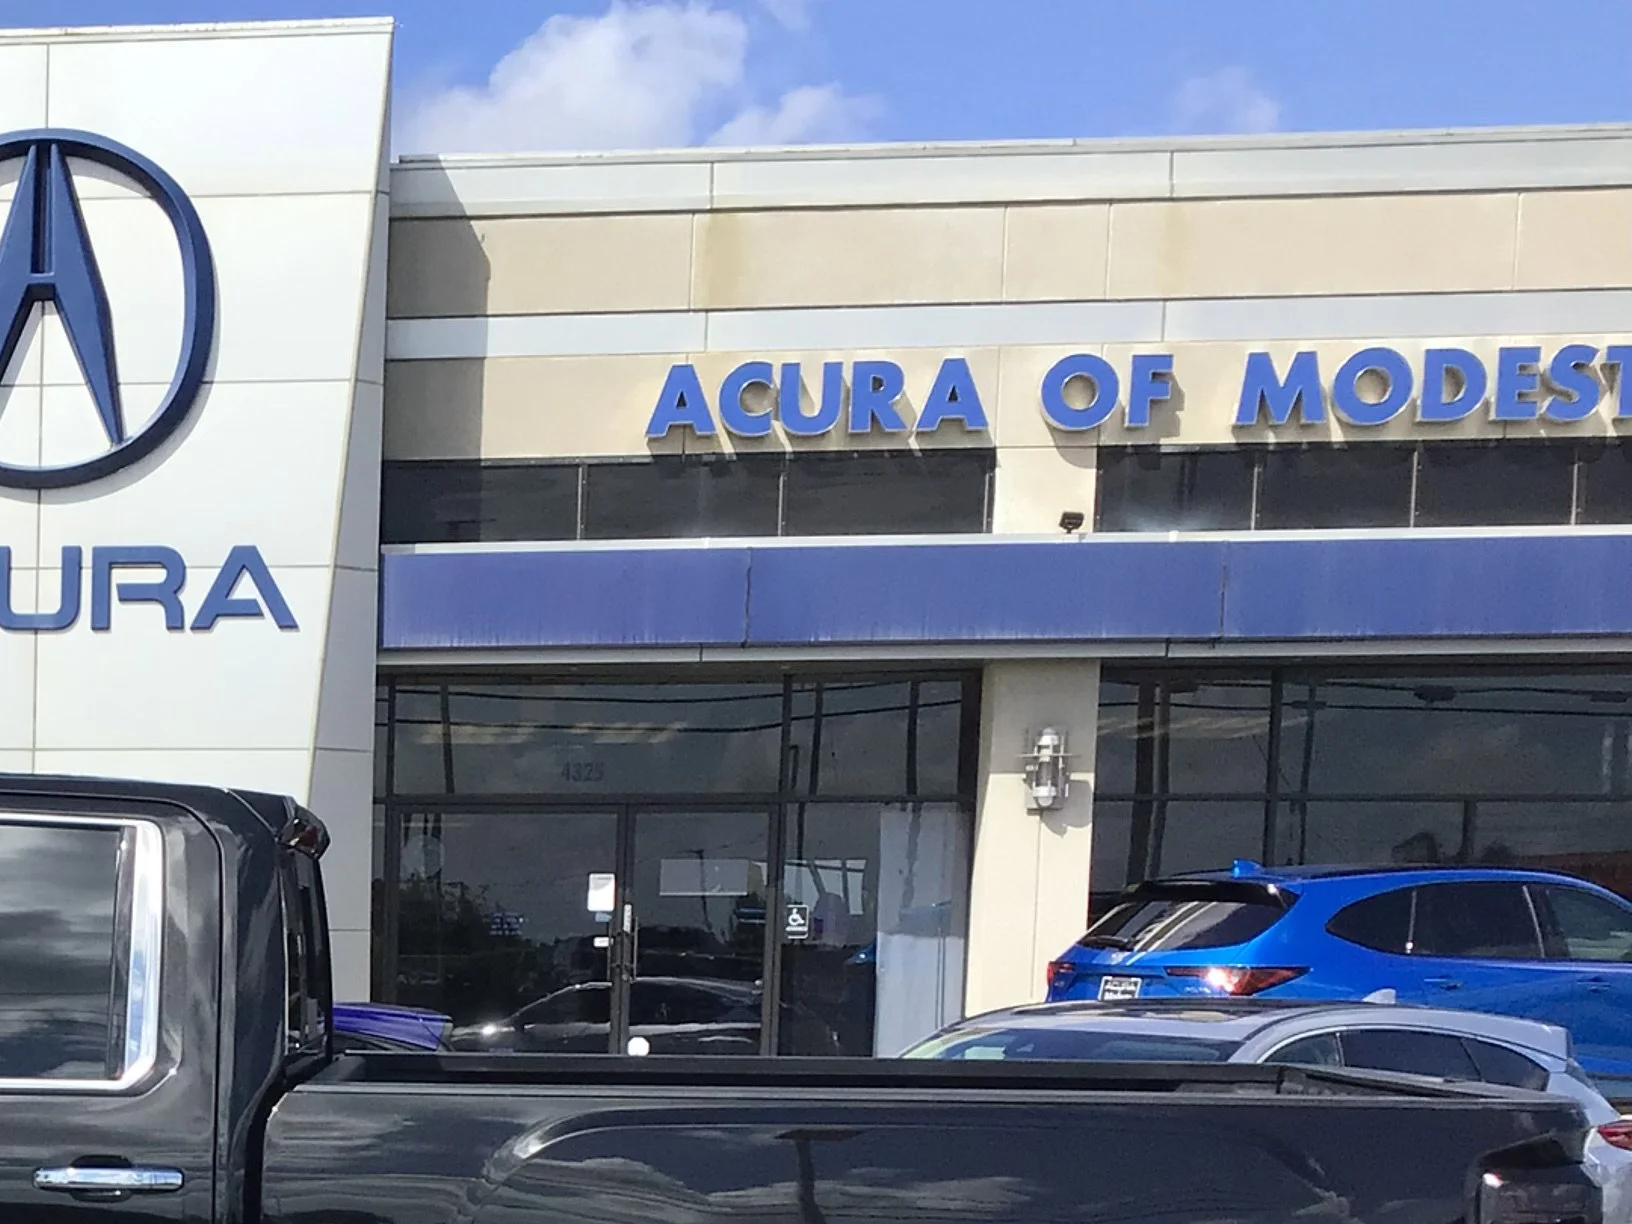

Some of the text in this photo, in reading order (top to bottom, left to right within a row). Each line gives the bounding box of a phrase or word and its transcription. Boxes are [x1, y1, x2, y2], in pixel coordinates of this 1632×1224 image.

[648, 357, 989, 437] ACURA
[1041, 353, 1174, 430] OF
[561, 761, 604, 782] 4325
